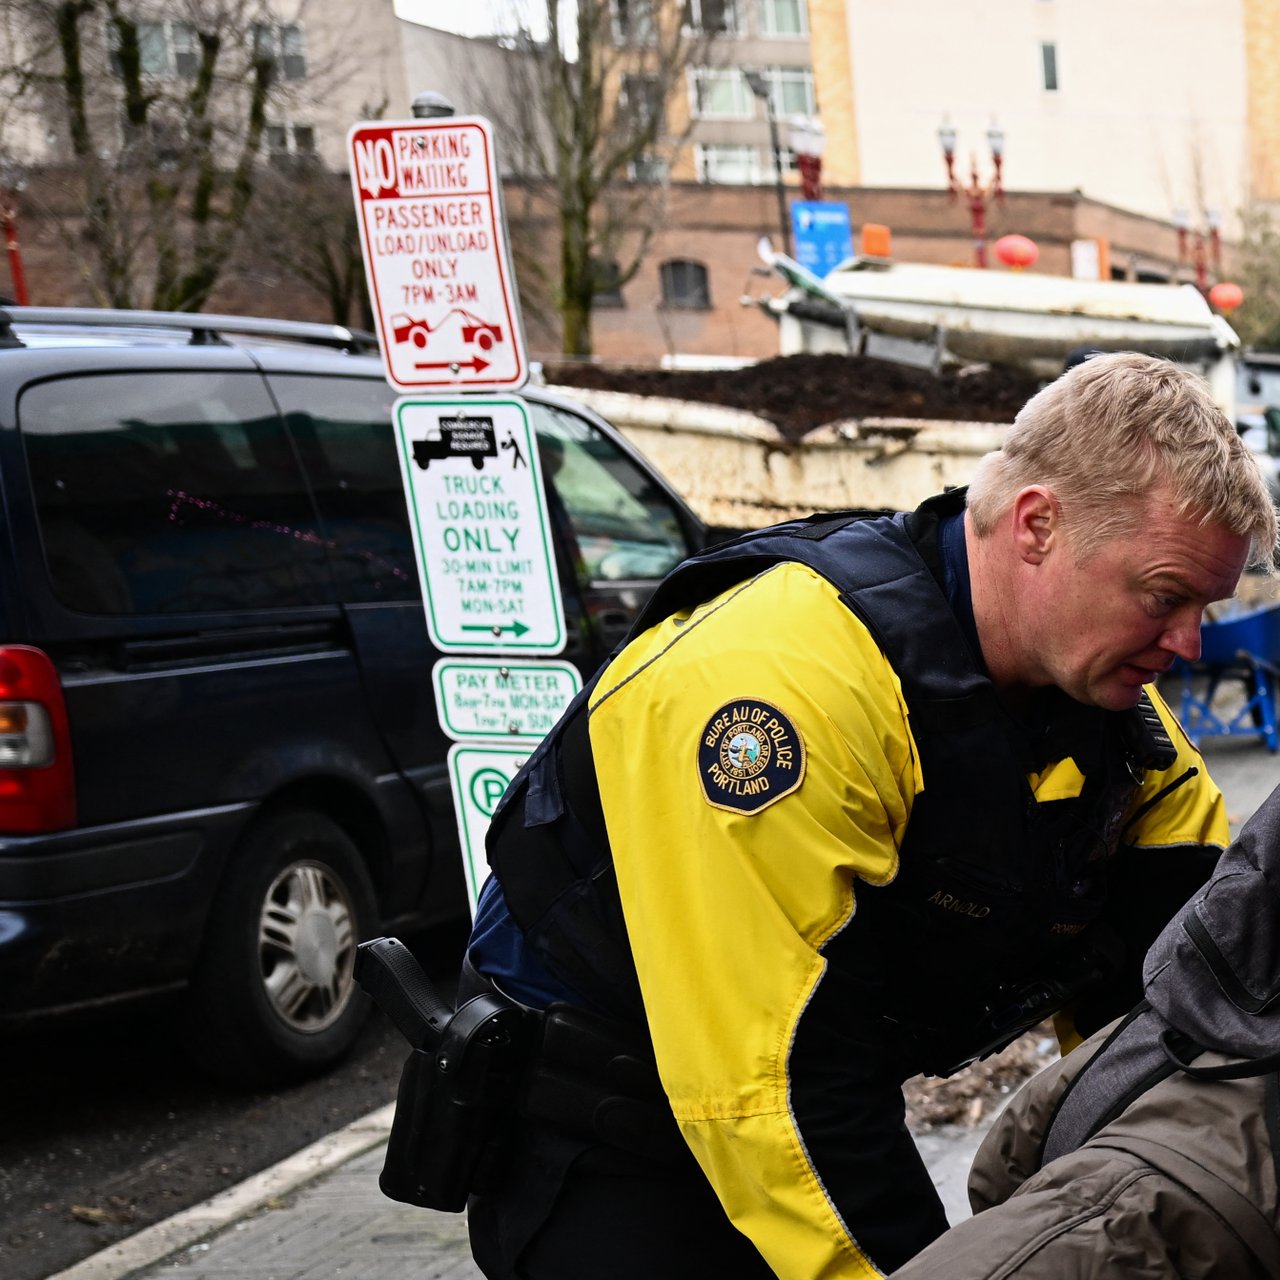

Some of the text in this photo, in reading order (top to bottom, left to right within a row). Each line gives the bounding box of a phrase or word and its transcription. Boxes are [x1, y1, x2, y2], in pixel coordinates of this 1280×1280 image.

[399, 133, 471, 161] PARKING
[355, 138, 397, 195] NO
[402, 163, 468, 190] WAITING
[374, 202, 484, 230] PASSENGER
[376, 231, 489, 257] LOAD/UNLOAD
[412, 258, 458, 279] ONLY
[442, 475, 504, 495] TRUCK
[436, 501, 520, 521] LOADING
[443, 527, 520, 553] ONLY
[442, 558, 533, 574] 30-MIN LIMIT
[457, 578, 522, 593] 7AM-7PM
[461, 598, 524, 613] MON-SAT
[456, 674, 559, 690] PAY METER
[705, 706, 792, 770] BUREAU OF POLICE
[708, 762, 770, 795] PORTLAND
[928, 890, 990, 918] ARNOLD
